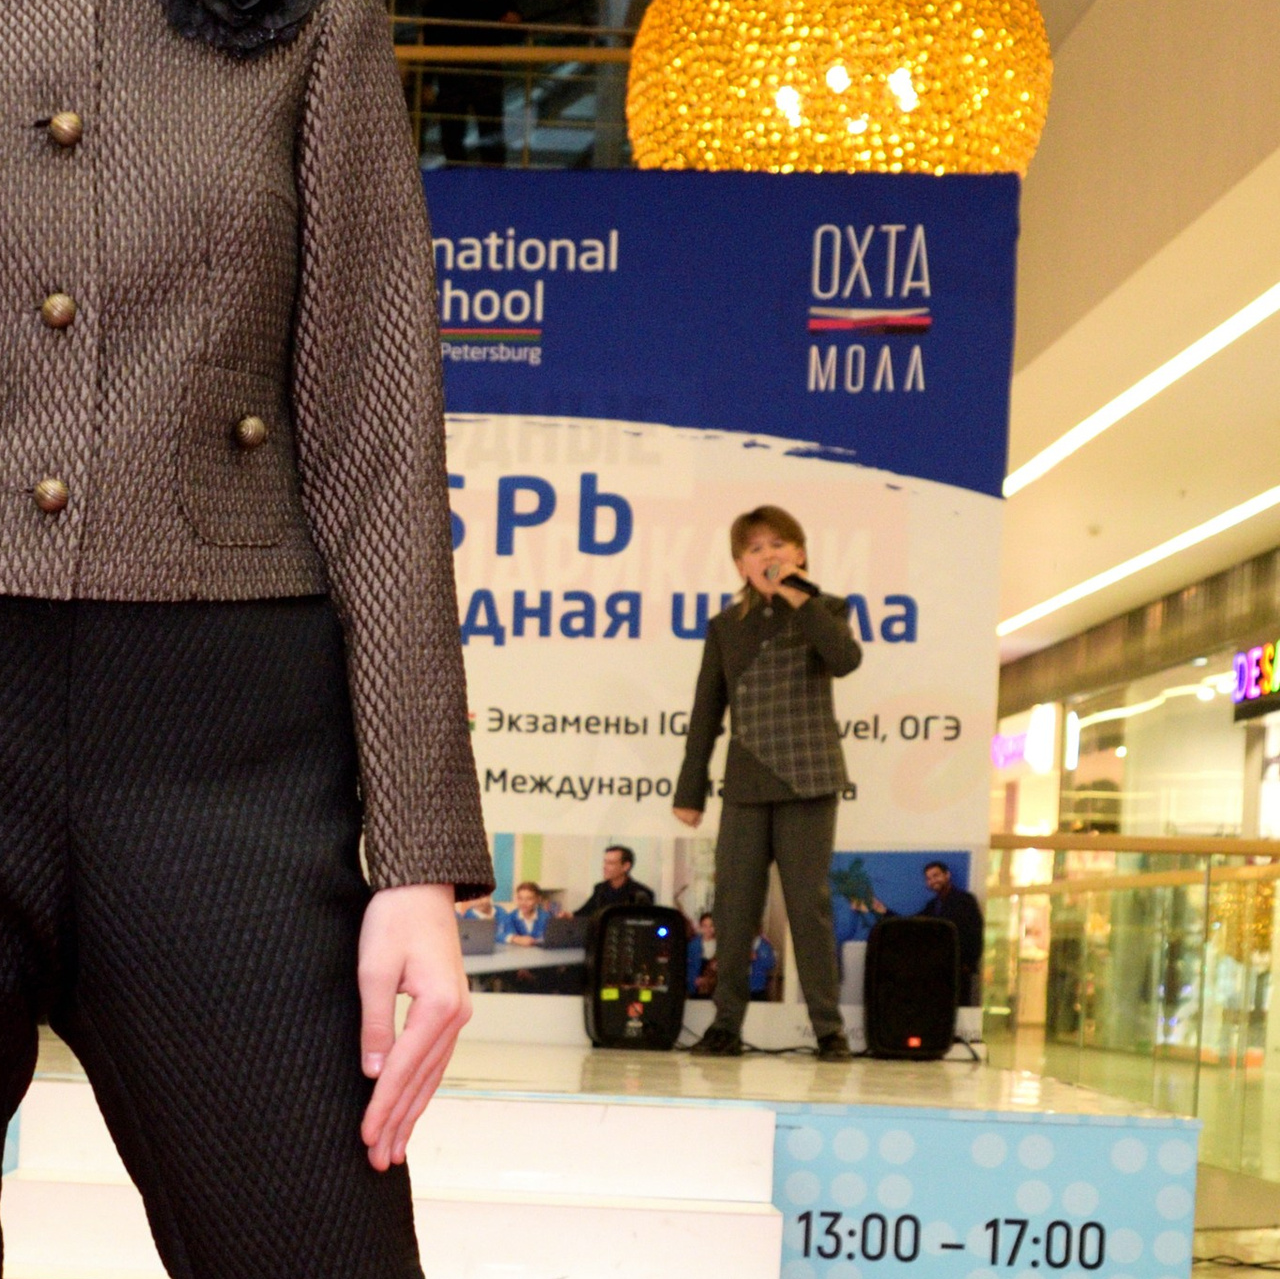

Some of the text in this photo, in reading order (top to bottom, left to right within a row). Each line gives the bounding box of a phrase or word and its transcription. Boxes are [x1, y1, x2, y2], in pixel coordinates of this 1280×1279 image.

[431, 227, 619, 271] national
[811, 223, 932, 300] ОХТА
[437, 279, 545, 322] hool
[441, 342, 543, 367] Petersburg
[807, 344, 926, 393] МОЛЛ
[461, 589, 919, 646] дная шла
[487, 707, 648, 736] Экзамены
[899, 715, 962, 741] ОГЭ
[484, 767, 724, 802] Междунаро
[796, 1209, 922, 1264] 13:00
[984, 1217, 1107, 1271] 17:00
